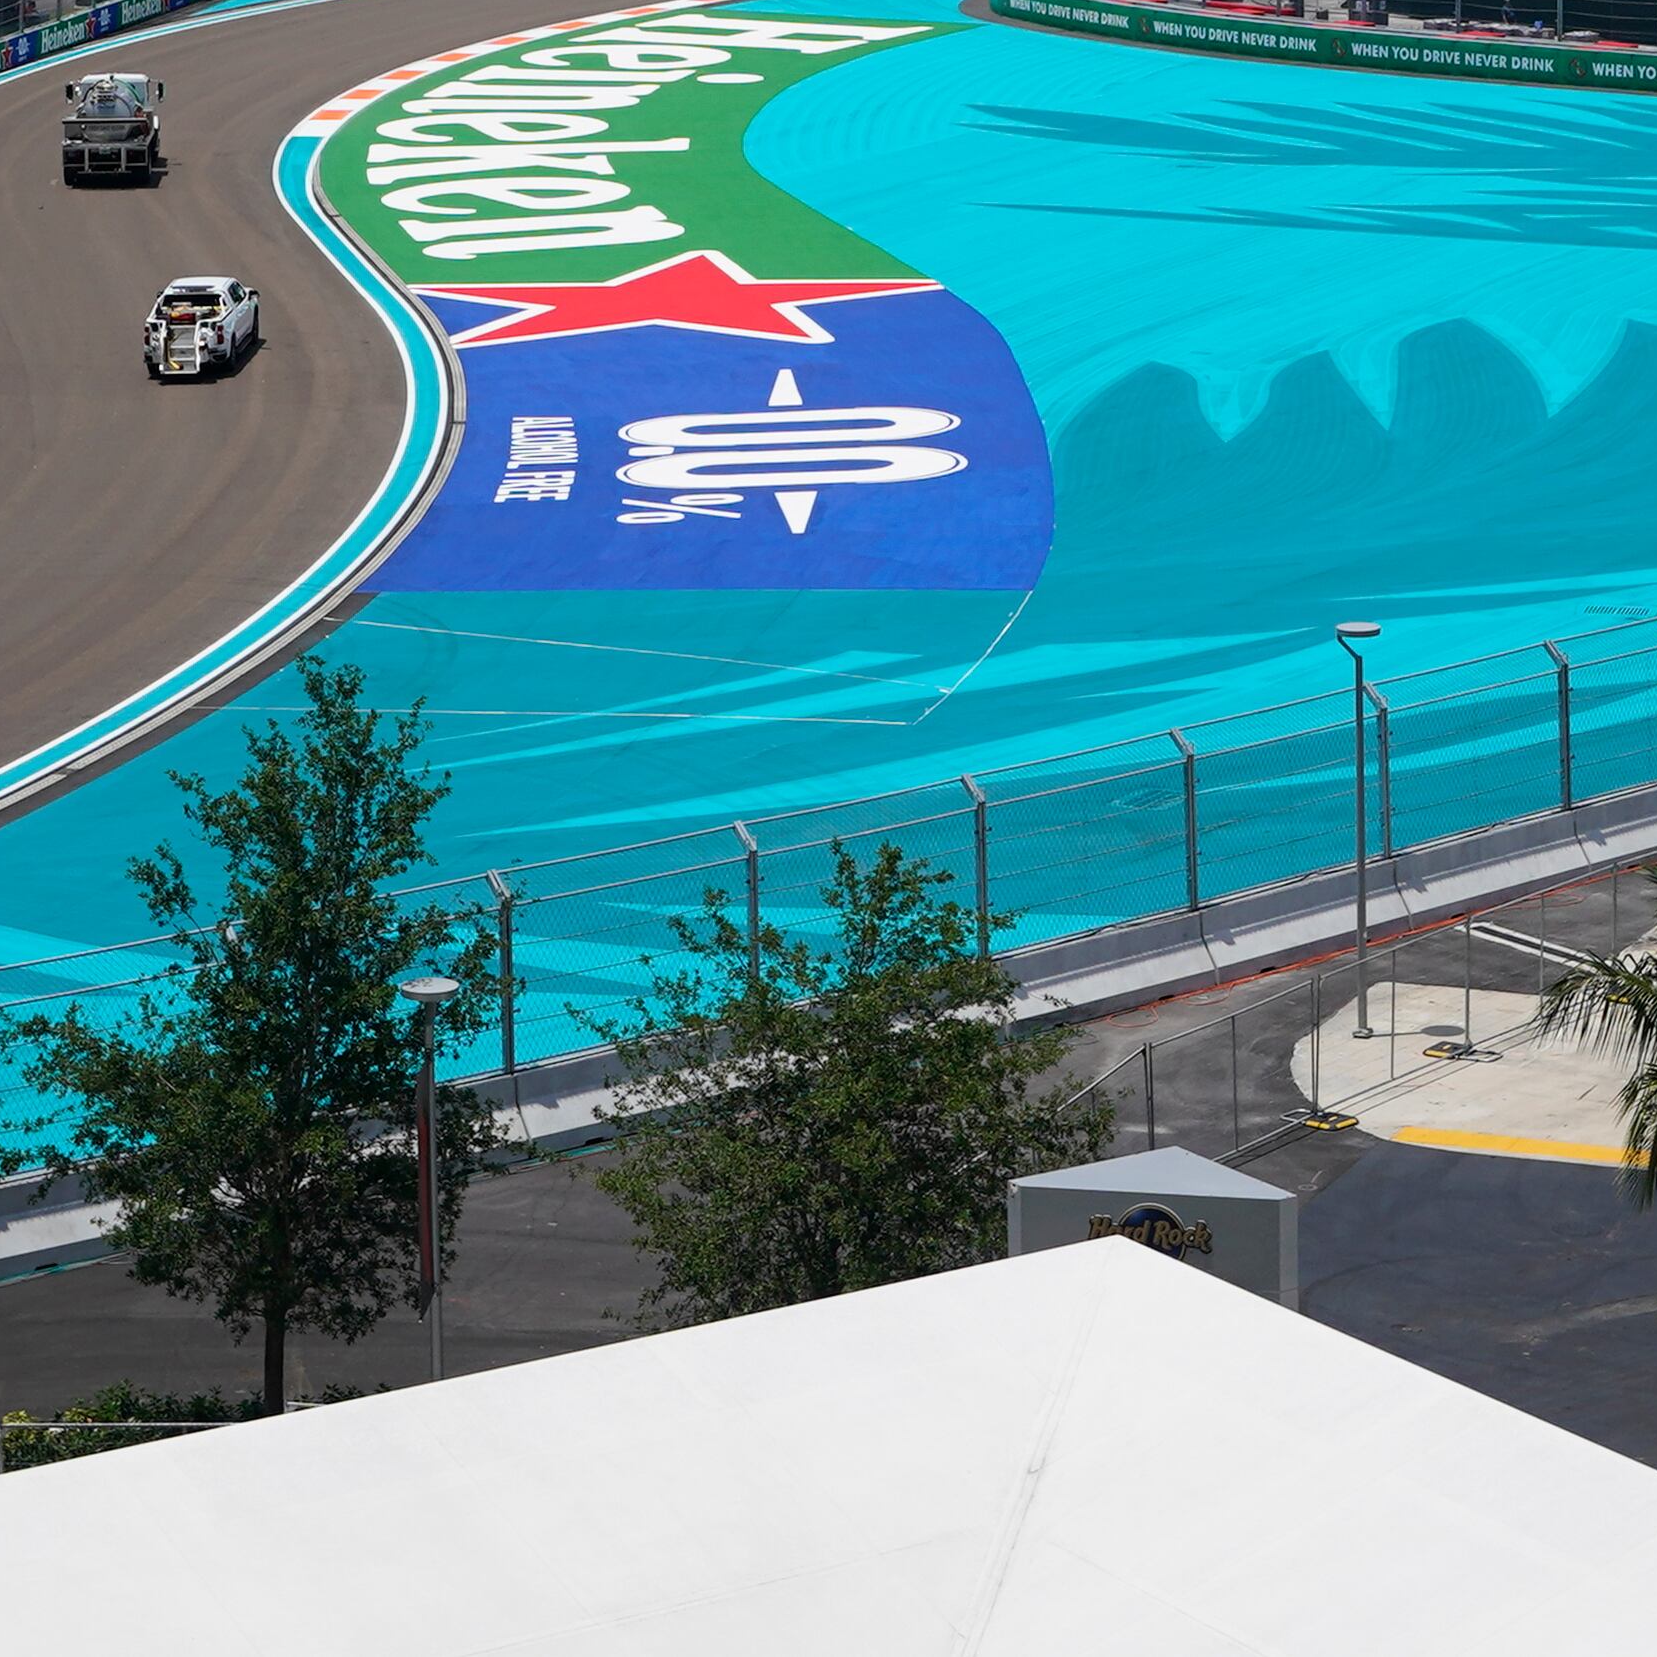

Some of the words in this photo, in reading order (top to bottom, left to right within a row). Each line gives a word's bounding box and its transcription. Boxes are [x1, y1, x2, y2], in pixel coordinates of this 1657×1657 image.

[1032, 0, 1047, 15] YOU
[1048, 3, 1072, 20] DRIVE
[1072, 7, 1099, 24] NEVER
[1101, 12, 1130, 29] DRINK
[41, 22, 85, 54] Heineken
[1153, 20, 1183, 36] WHEN
[1184, 24, 1206, 40] YOU
[1208, 28, 1239, 44] DRIVE
[1241, 31, 1276, 48] NEVER
[1279, 36, 1317, 53] DRINK
[1351, 42, 1389, 58] WHEN
[1391, 45, 1420, 61] YOU
[1422, 49, 1461, 66] DRIVE
[1464, 53, 1507, 69] NEVER
[1510, 56, 1555, 73] DRINK
[1592, 62, 1634, 78] WHEN
[366, 13, 934, 260] Heineken
[507, 416, 578, 469] ALCOHOL
[494, 470, 576, 503] FREE
[1089, 1213, 1150, 1244] Hard
[1151, 1218, 1213, 1255] Rock
